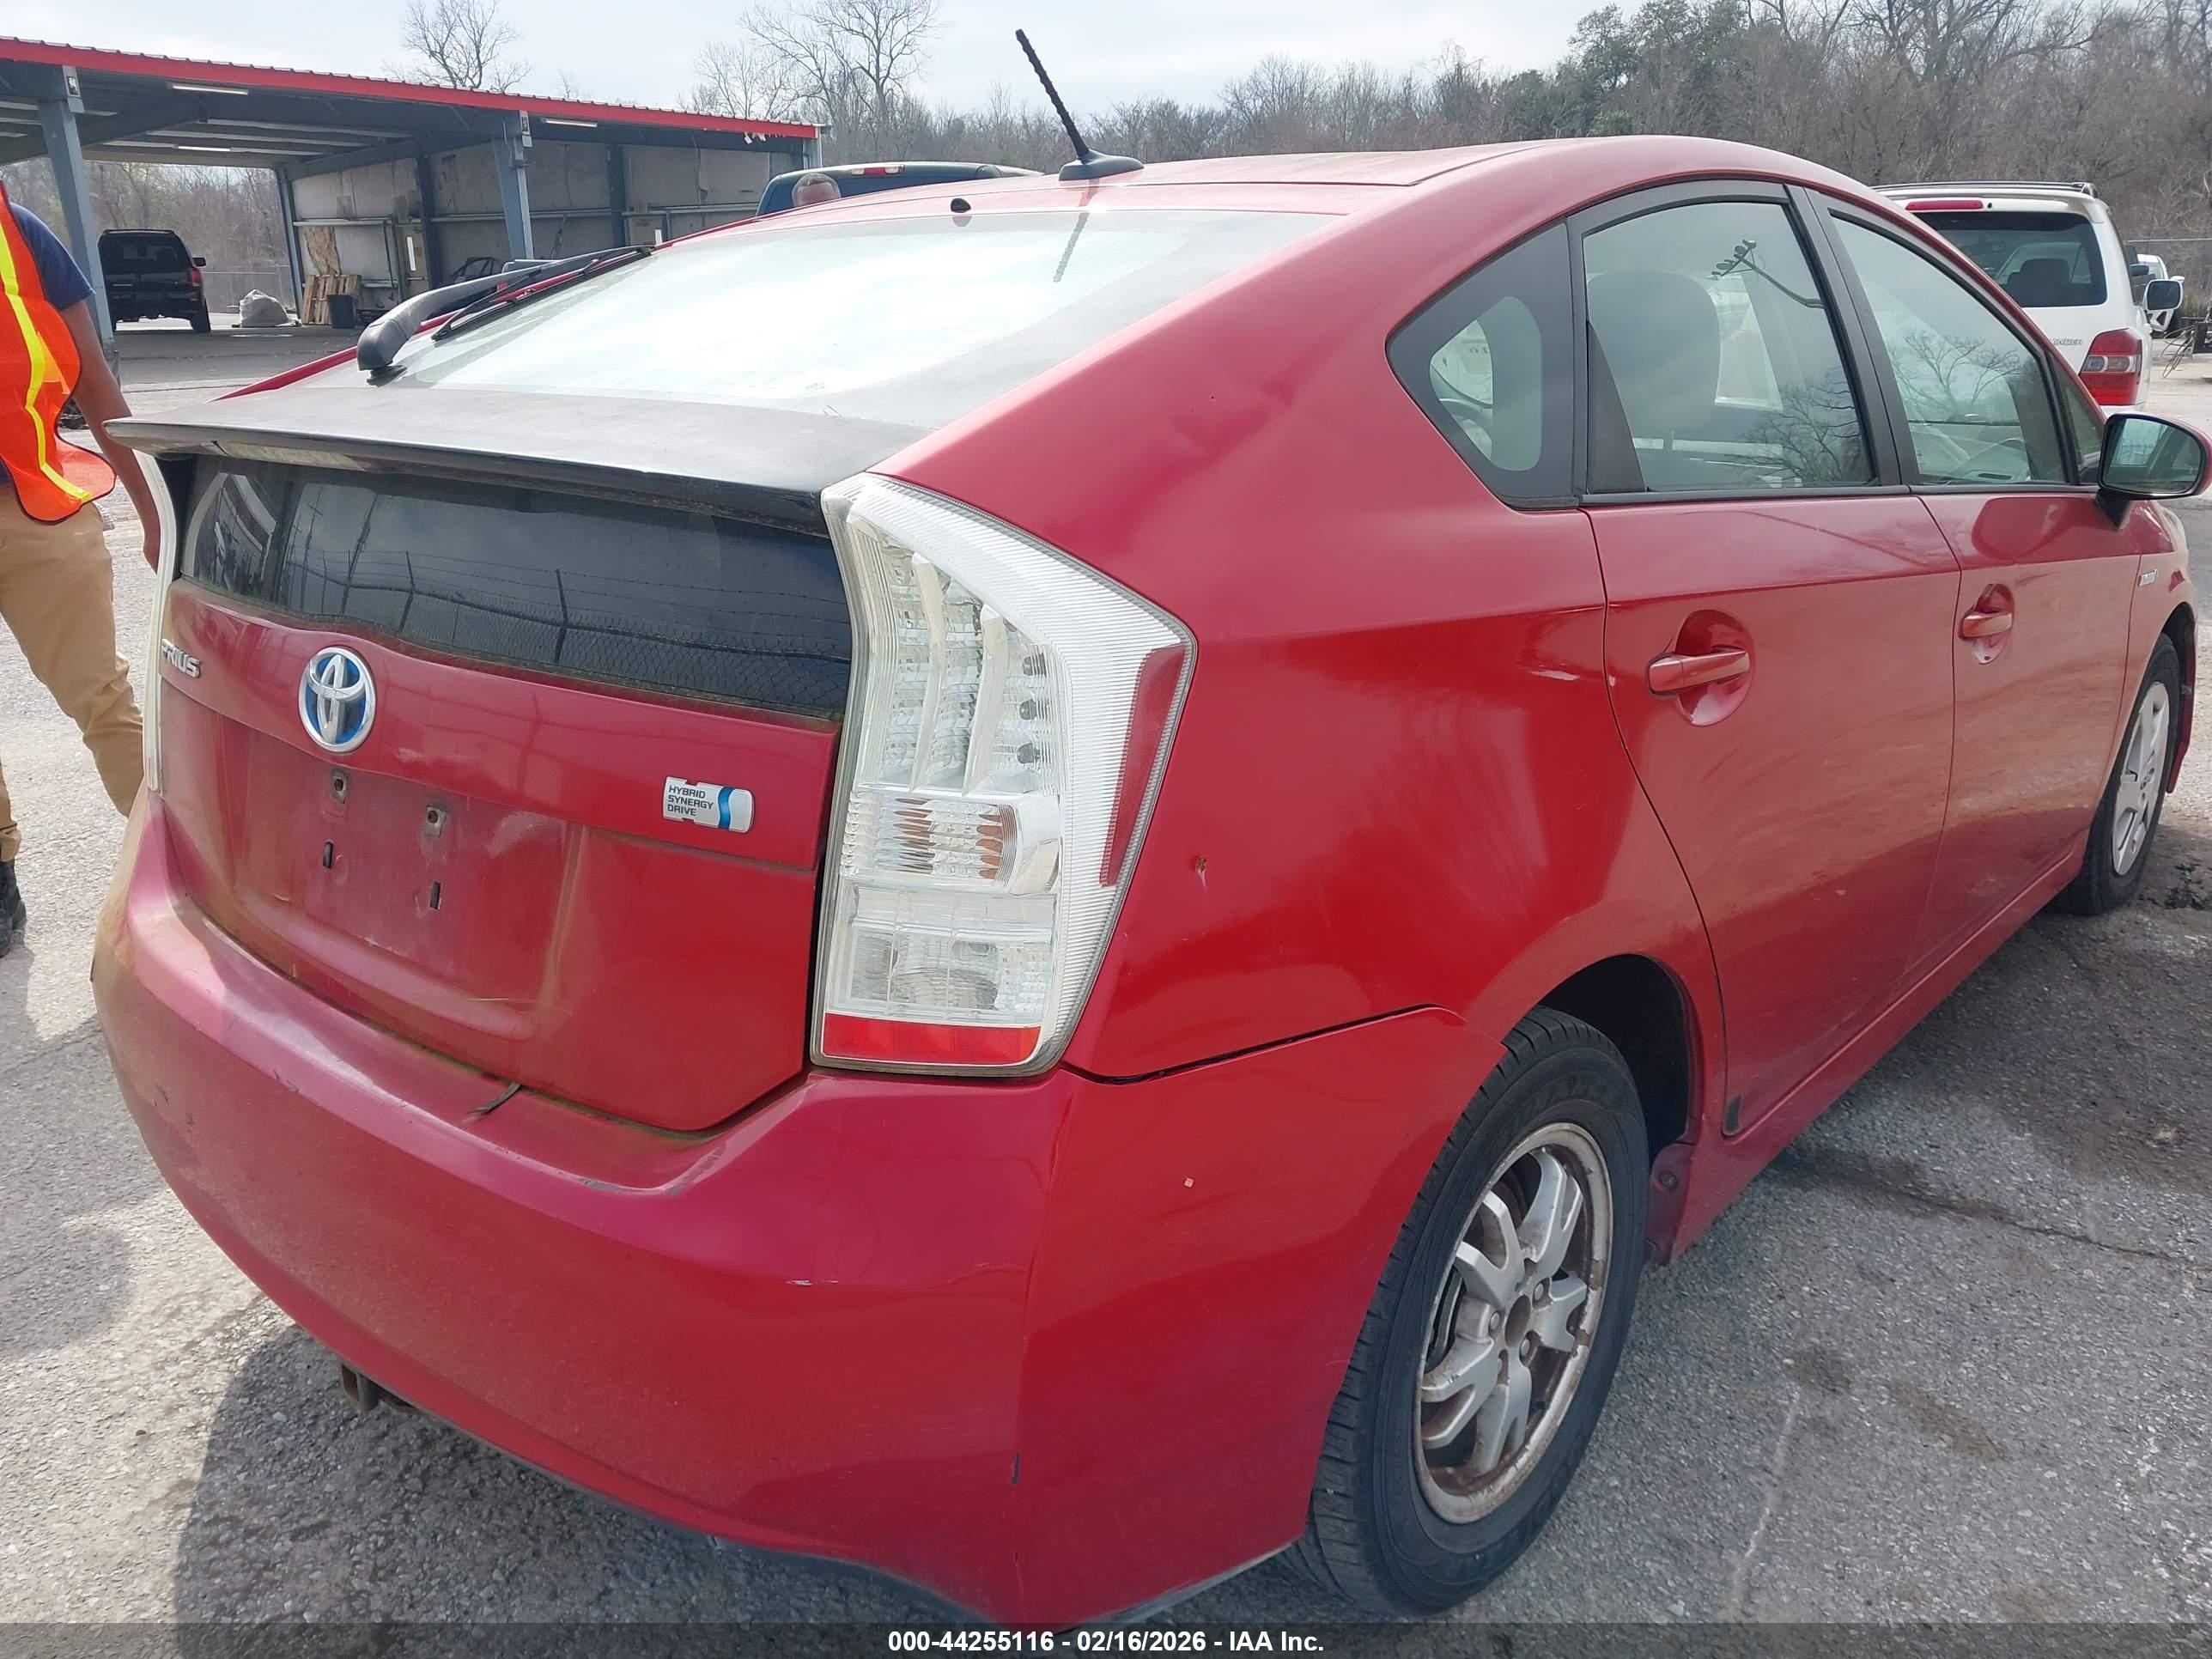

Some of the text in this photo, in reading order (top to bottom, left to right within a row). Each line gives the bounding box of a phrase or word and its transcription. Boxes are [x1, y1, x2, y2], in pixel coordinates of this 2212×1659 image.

[161, 638, 201, 678] PRIUS
[668, 785, 706, 799] HYBRID
[667, 794, 714, 810] SYNERGY
[666, 804, 696, 817] DRIVE
